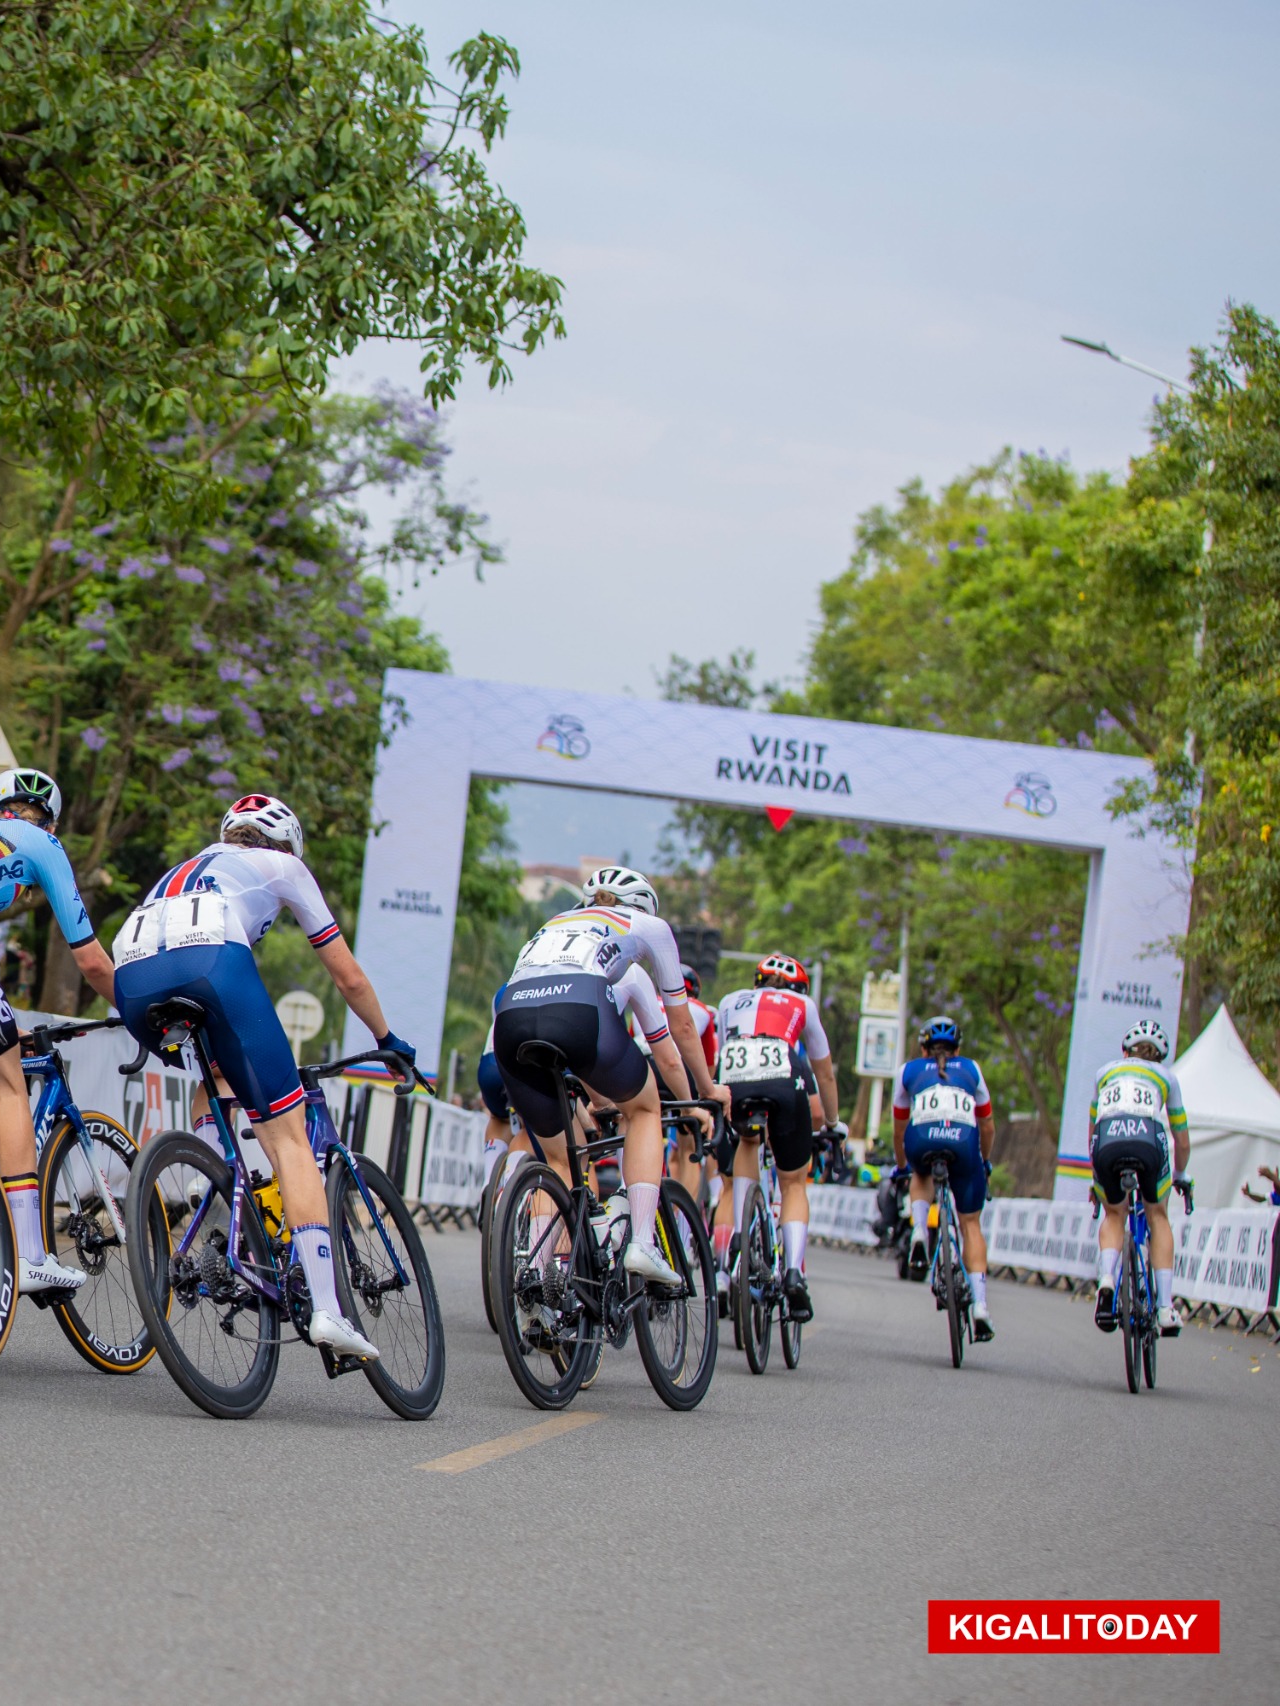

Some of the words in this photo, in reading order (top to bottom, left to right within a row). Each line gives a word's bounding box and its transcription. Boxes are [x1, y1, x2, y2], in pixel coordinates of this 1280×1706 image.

[750, 734, 829, 765] VISIT
[716, 756, 853, 795] RWANDA
[395, 888, 432, 901] VISIT
[379, 898, 444, 917] RWANDA
[132, 914, 146, 944] 1
[191, 897, 201, 927] 1
[185, 931, 204, 940] VISIT
[561, 934, 581, 952] 7
[125, 947, 142, 957] VISIT
[597, 942, 622, 970] KTM
[511, 983, 573, 1001] GERMANY
[1116, 980, 1152, 995] VISIT
[1101, 990, 1163, 1010] RWANDA
[725, 1046, 747, 1071] 53
[760, 1045, 782, 1067] 53
[922, 1092, 939, 1111] 16
[953, 1092, 971, 1112] 16
[1102, 1087, 1121, 1106] 38
[1133, 1087, 1153, 1106] 38
[928, 1127, 962, 1140] FRANCE
[26, 1269, 83, 1289] SPECIALIZED
[87, 1331, 142, 1361] roval
